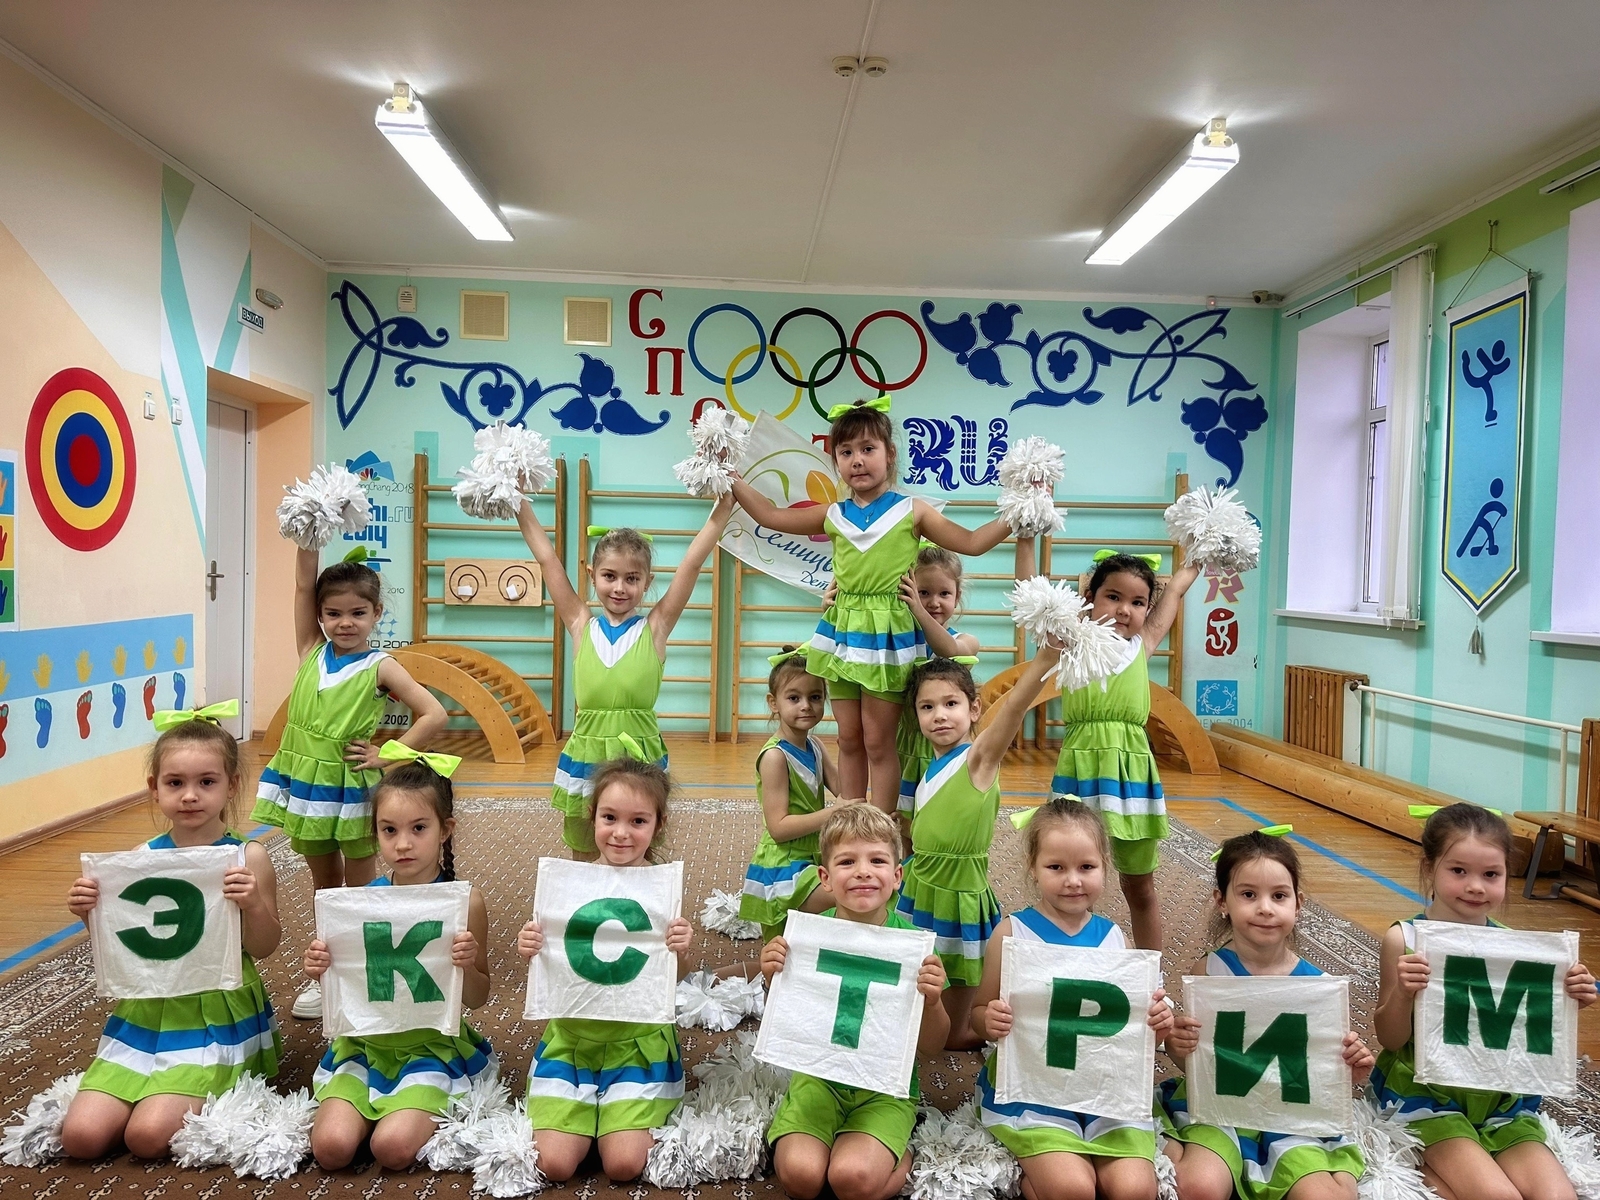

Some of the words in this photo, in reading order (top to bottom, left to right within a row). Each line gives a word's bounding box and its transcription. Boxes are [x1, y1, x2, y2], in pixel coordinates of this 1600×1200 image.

[242, 309, 263, 328] ВЫХОД
[391, 482, 414, 494] 2018
[387, 587, 405, 595] 2010
[383, 714, 409, 726] 2002
[116, 877, 205, 960] Э
[564, 897, 652, 985] С
[363, 921, 444, 1003] К
[816, 949, 902, 1049] Т
[1046, 977, 1131, 1070] Р
[1443, 955, 1556, 1055] М
[1214, 1010, 1310, 1103] И
